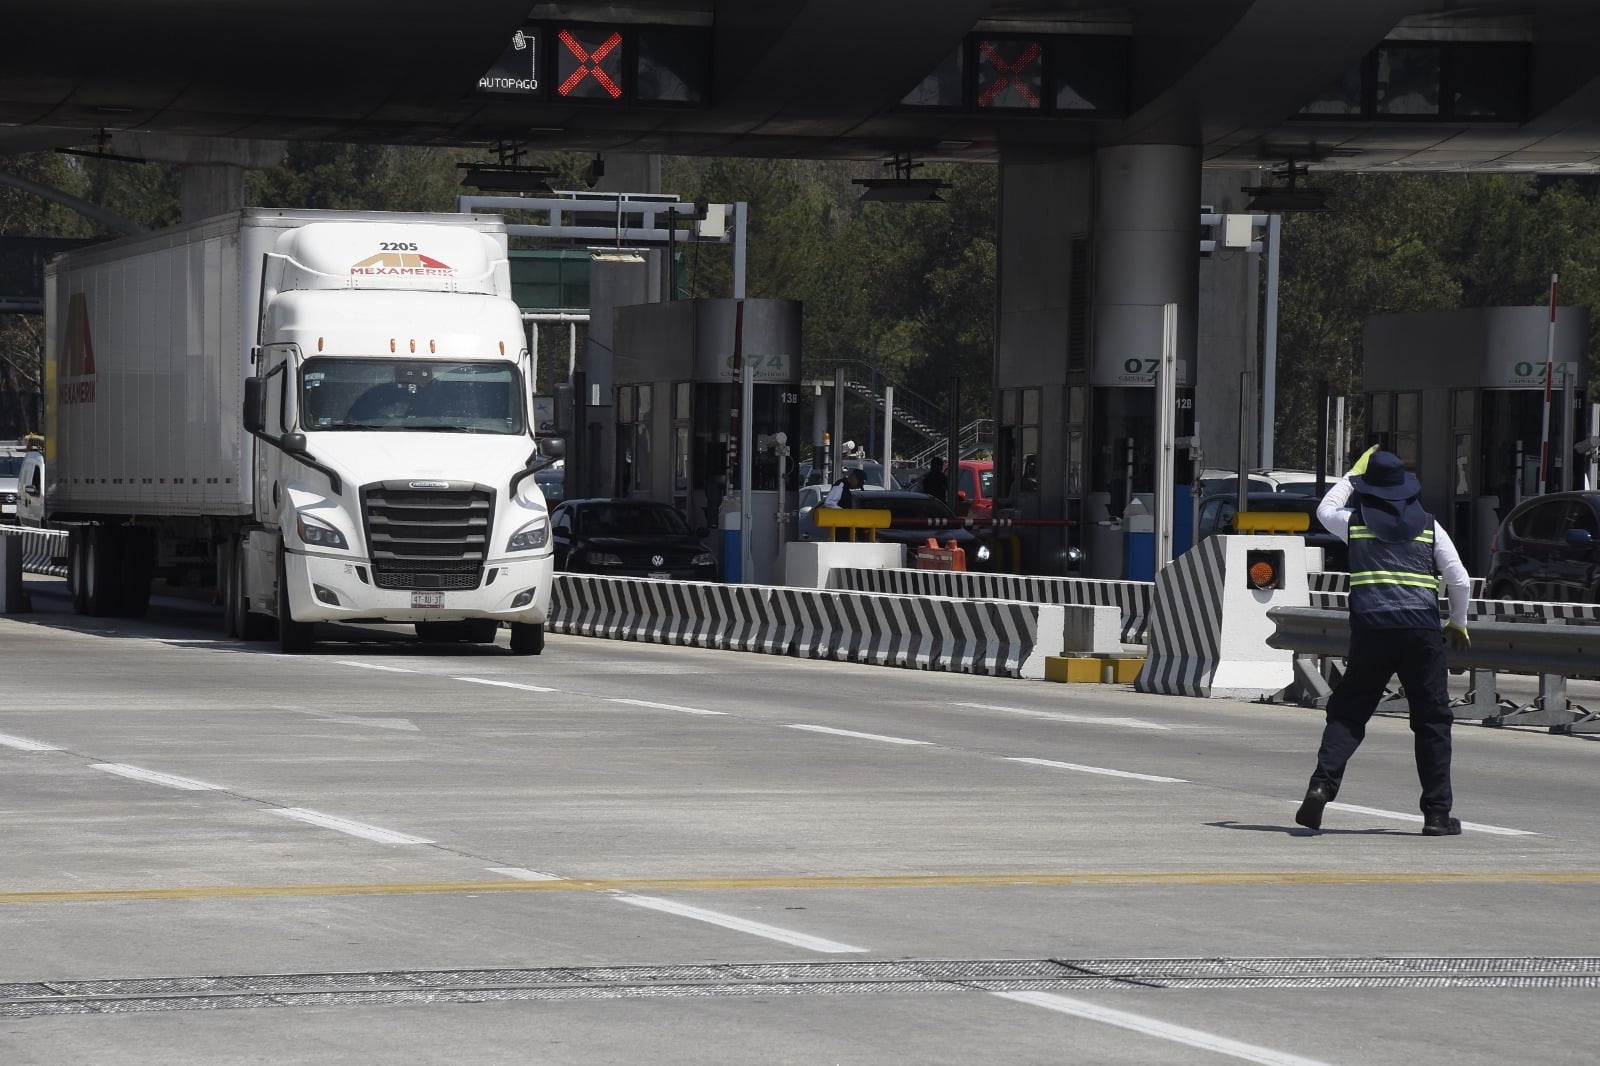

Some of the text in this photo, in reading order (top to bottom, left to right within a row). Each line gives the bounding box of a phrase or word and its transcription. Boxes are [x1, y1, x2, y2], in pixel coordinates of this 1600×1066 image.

[479, 77, 538, 89] AUTOPAGO
[380, 242, 418, 251] 2205
[351, 268, 454, 277] MEXAMERIK
[1124, 358, 1168, 374] 07
[781, 392, 798, 404] 13B
